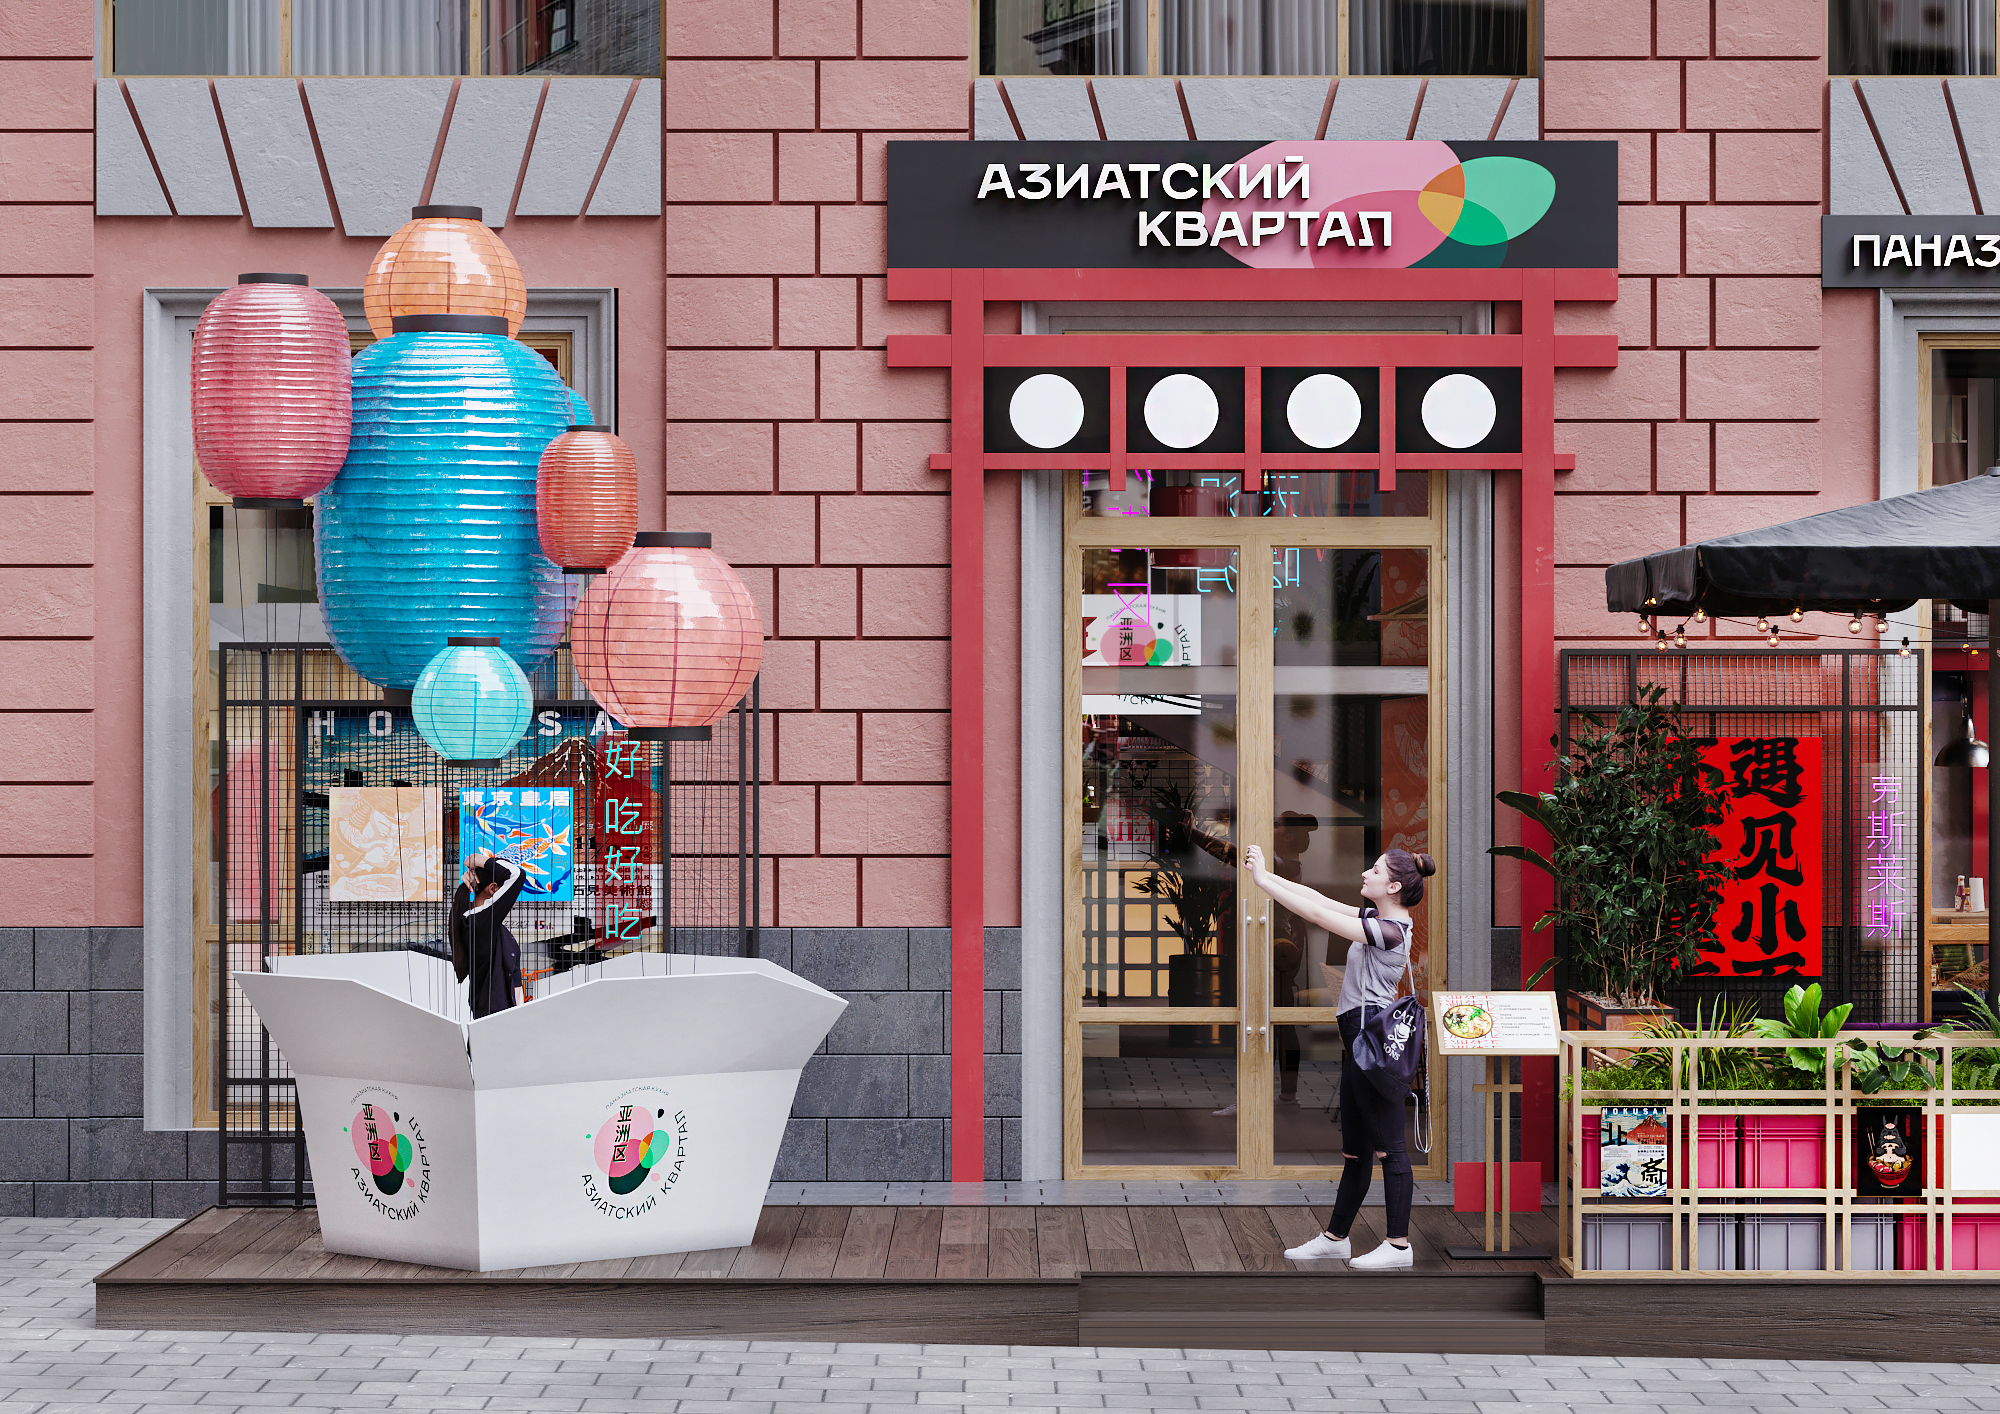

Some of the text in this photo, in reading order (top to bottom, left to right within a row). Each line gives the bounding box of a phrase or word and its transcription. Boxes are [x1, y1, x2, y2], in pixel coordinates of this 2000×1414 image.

[977, 155, 1311, 200] АЗИАТСКИЙ
[1137, 210, 1393, 248] КВАРТАЛ
[1853, 234, 2000, 268] ПАНАЗ
[1119, 617, 1133, 661] 亚洲区
[461, 790, 570, 810] 東京皇居
[604, 741, 643, 940] 好吃好吃
[1865, 773, 1907, 939] 劳斯莱斯
[361, 1103, 382, 1161] 亚洲区
[613, 1105, 633, 1162] 亚洲区
[1602, 1107, 1667, 1115] HOKUSAI
[351, 1116, 431, 1222] АЗИАТСКИЙ КВАРТАЛ
[581, 1109, 689, 1220] АЗИАТСКИЙ КВАРТАЛ
